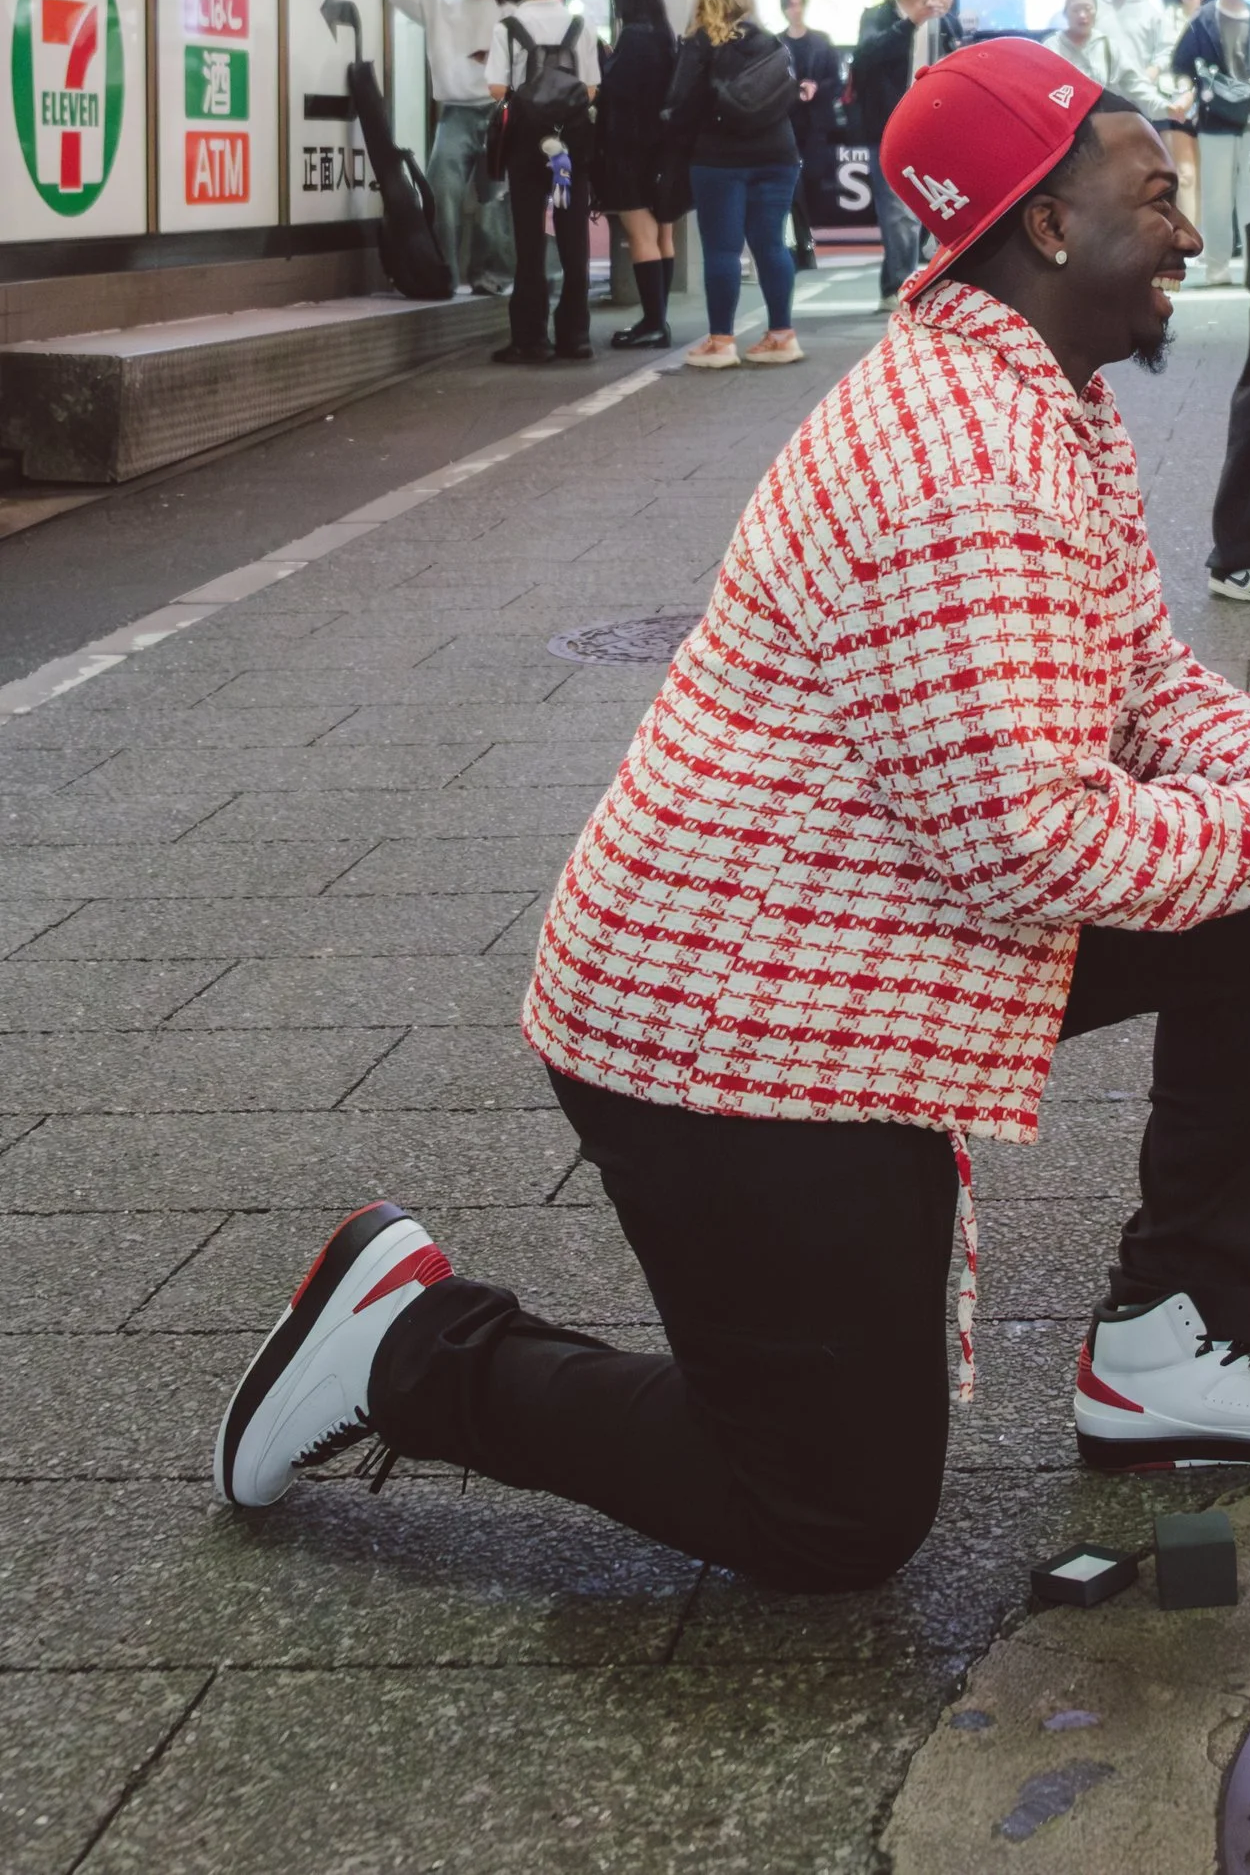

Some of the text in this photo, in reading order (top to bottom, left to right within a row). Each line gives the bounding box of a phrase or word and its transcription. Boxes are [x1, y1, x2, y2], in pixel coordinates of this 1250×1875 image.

[203, 51, 231, 115] 酒
[193, 139, 243, 198] ATM
[302, 146, 366, 192] 正面入口
[902, 166, 971, 221] LA
